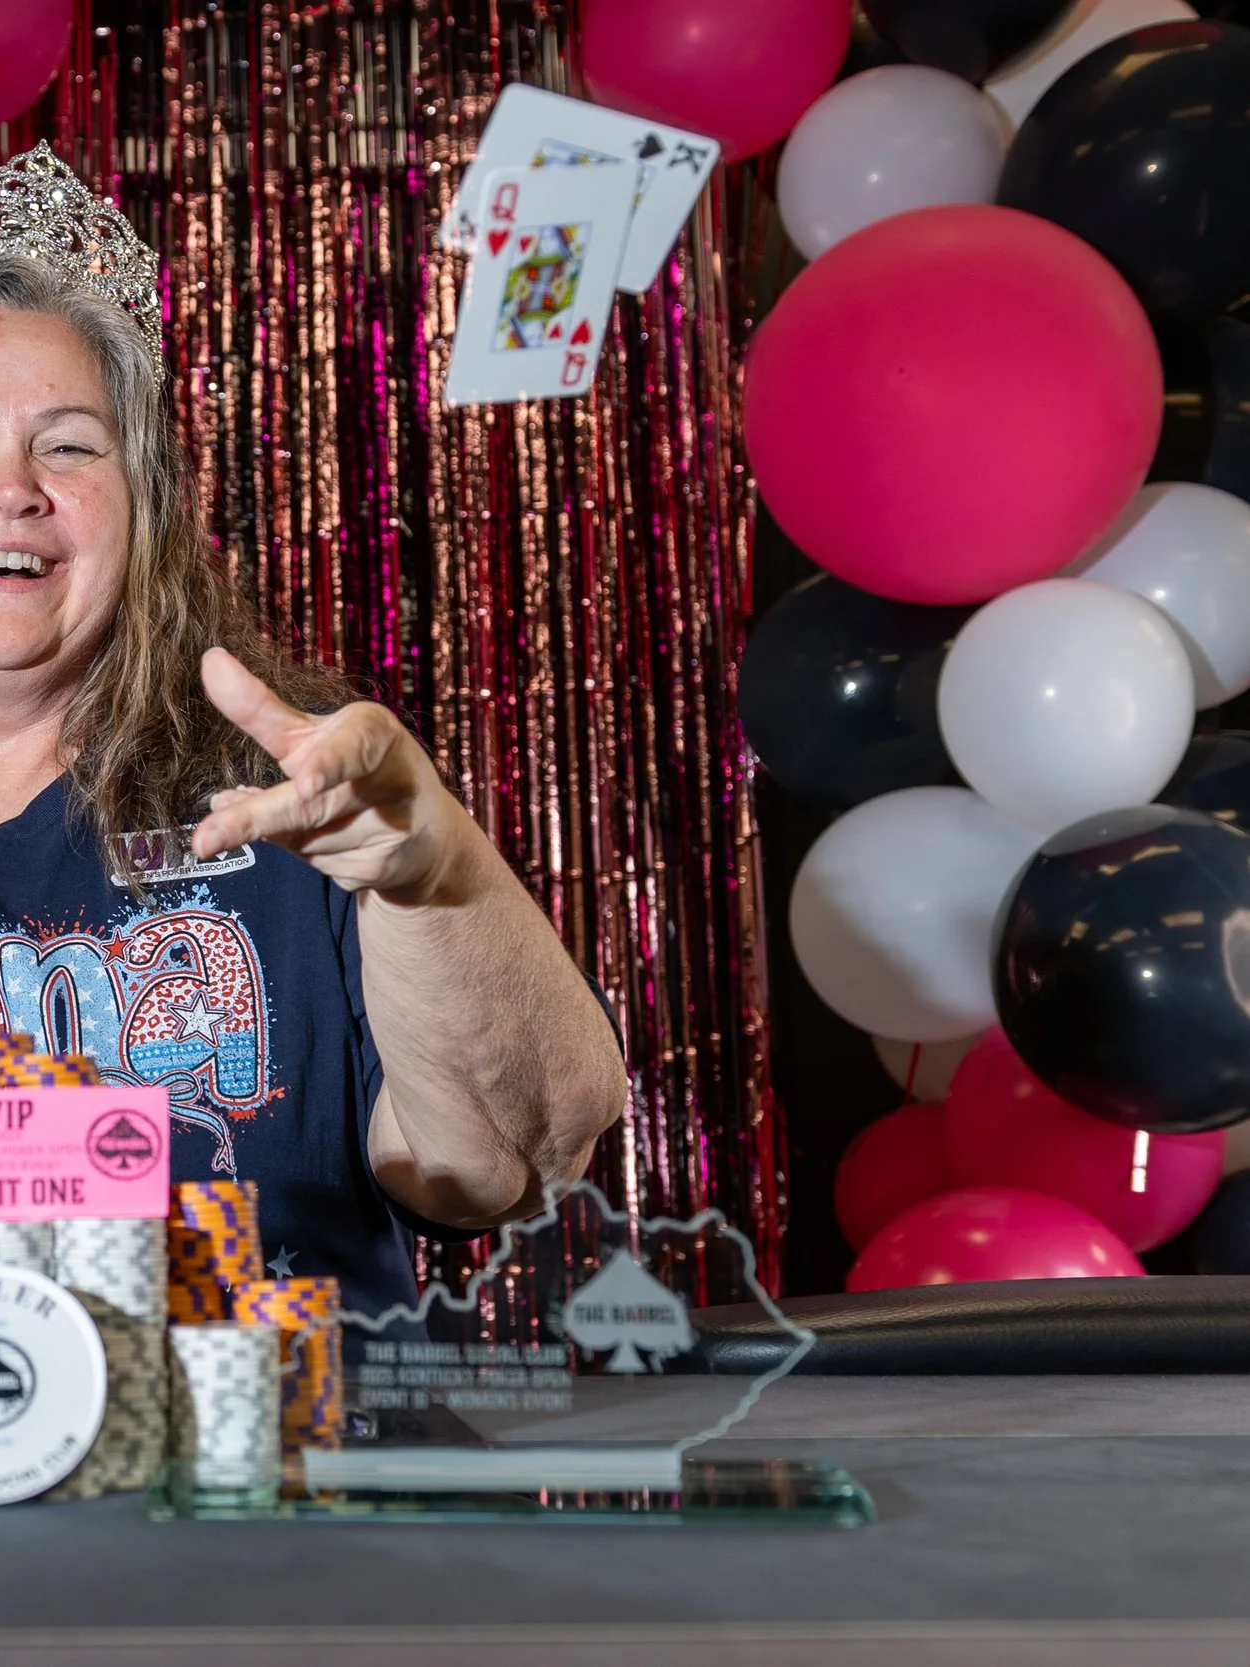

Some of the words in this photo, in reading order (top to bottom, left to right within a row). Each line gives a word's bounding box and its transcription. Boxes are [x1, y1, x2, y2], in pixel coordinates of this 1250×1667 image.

[668, 140, 709, 175] K
[490, 182, 520, 224] Q
[561, 351, 587, 388] Q
[163, 867, 191, 878] POKER
[192, 857, 250, 873] ASSOCIATION
[31, 1177, 85, 1206] ONE
[575, 1305, 604, 1325] THE
